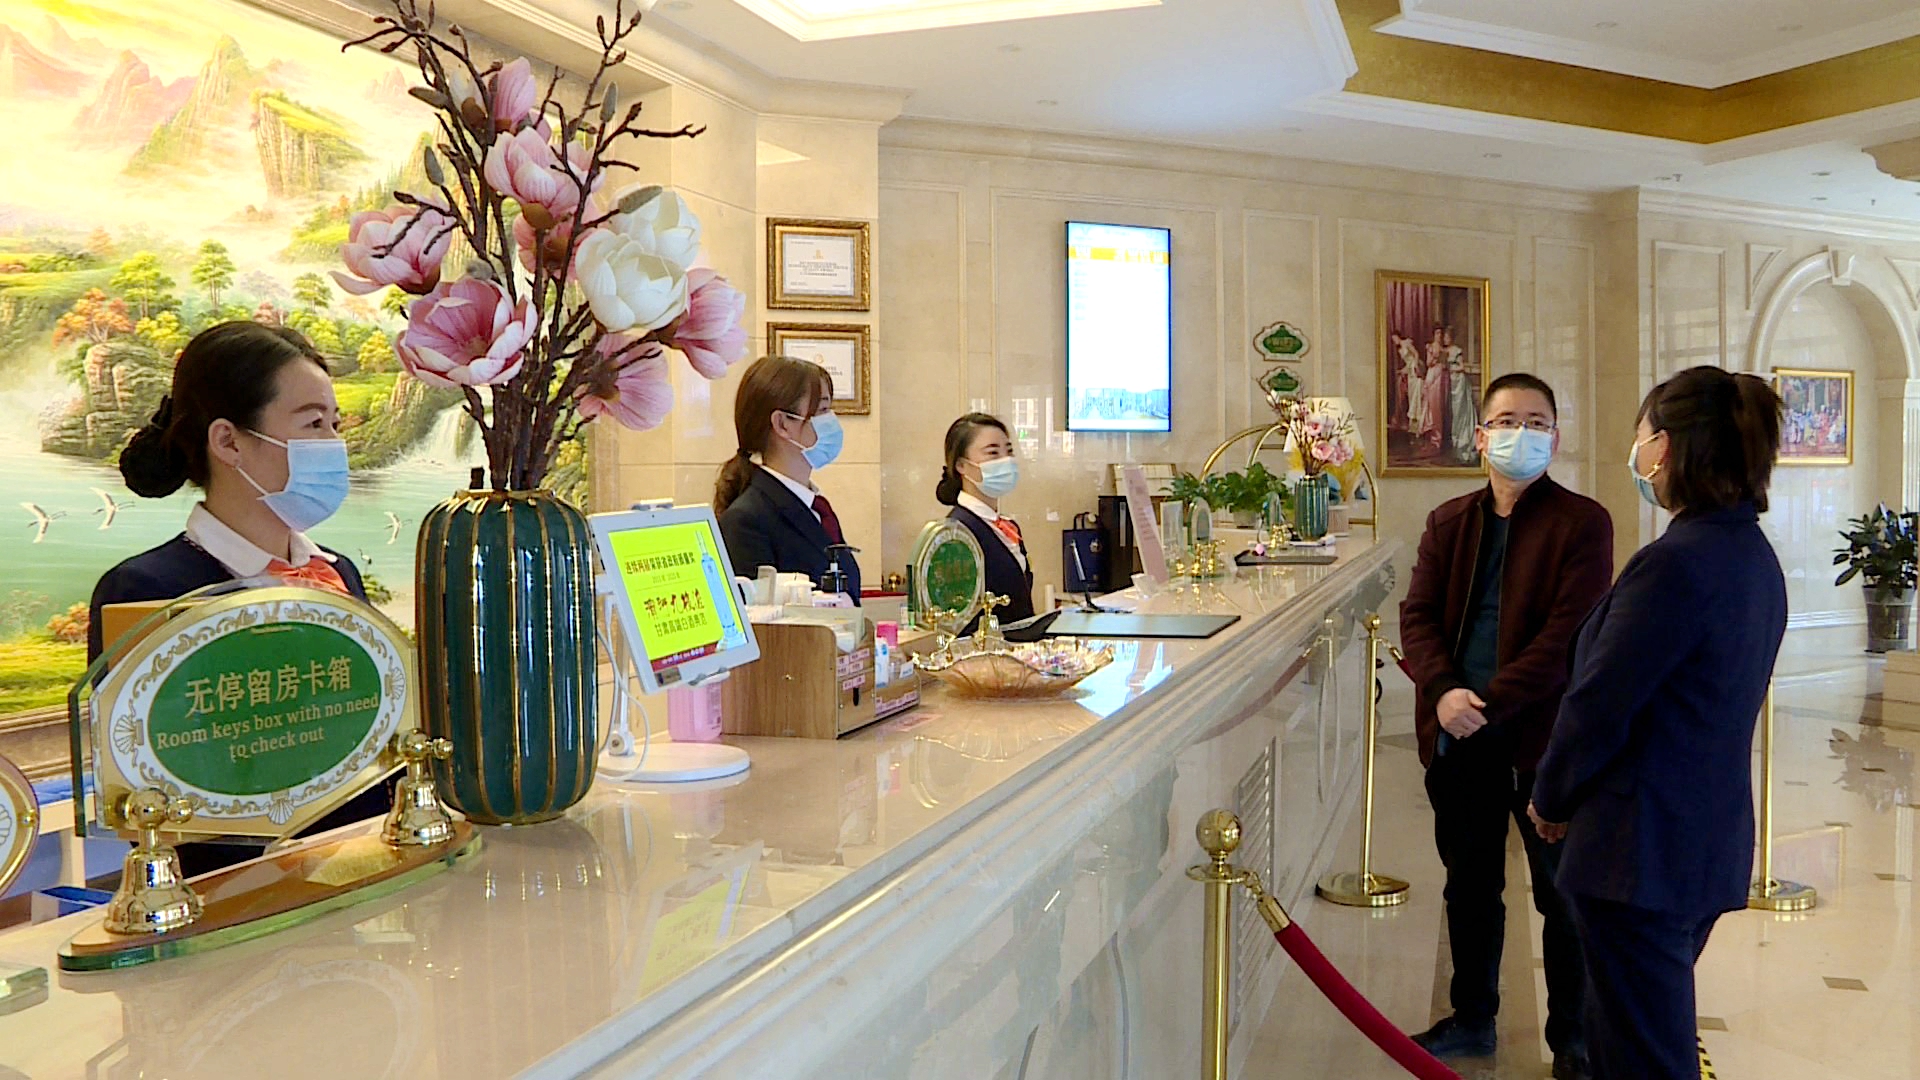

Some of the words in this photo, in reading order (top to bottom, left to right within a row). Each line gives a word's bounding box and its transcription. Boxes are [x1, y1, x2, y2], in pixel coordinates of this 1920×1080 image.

[185, 656, 352, 718] 无停留房卡箱
[156, 728, 208, 751] Room
[212, 720, 251, 743] keys
[254, 713, 283, 731] box
[286, 705, 322, 725] with
[324, 702, 343, 718] no
[346, 692, 379, 714] need
[250, 733, 296, 755] check
[299, 726, 325, 745] out
